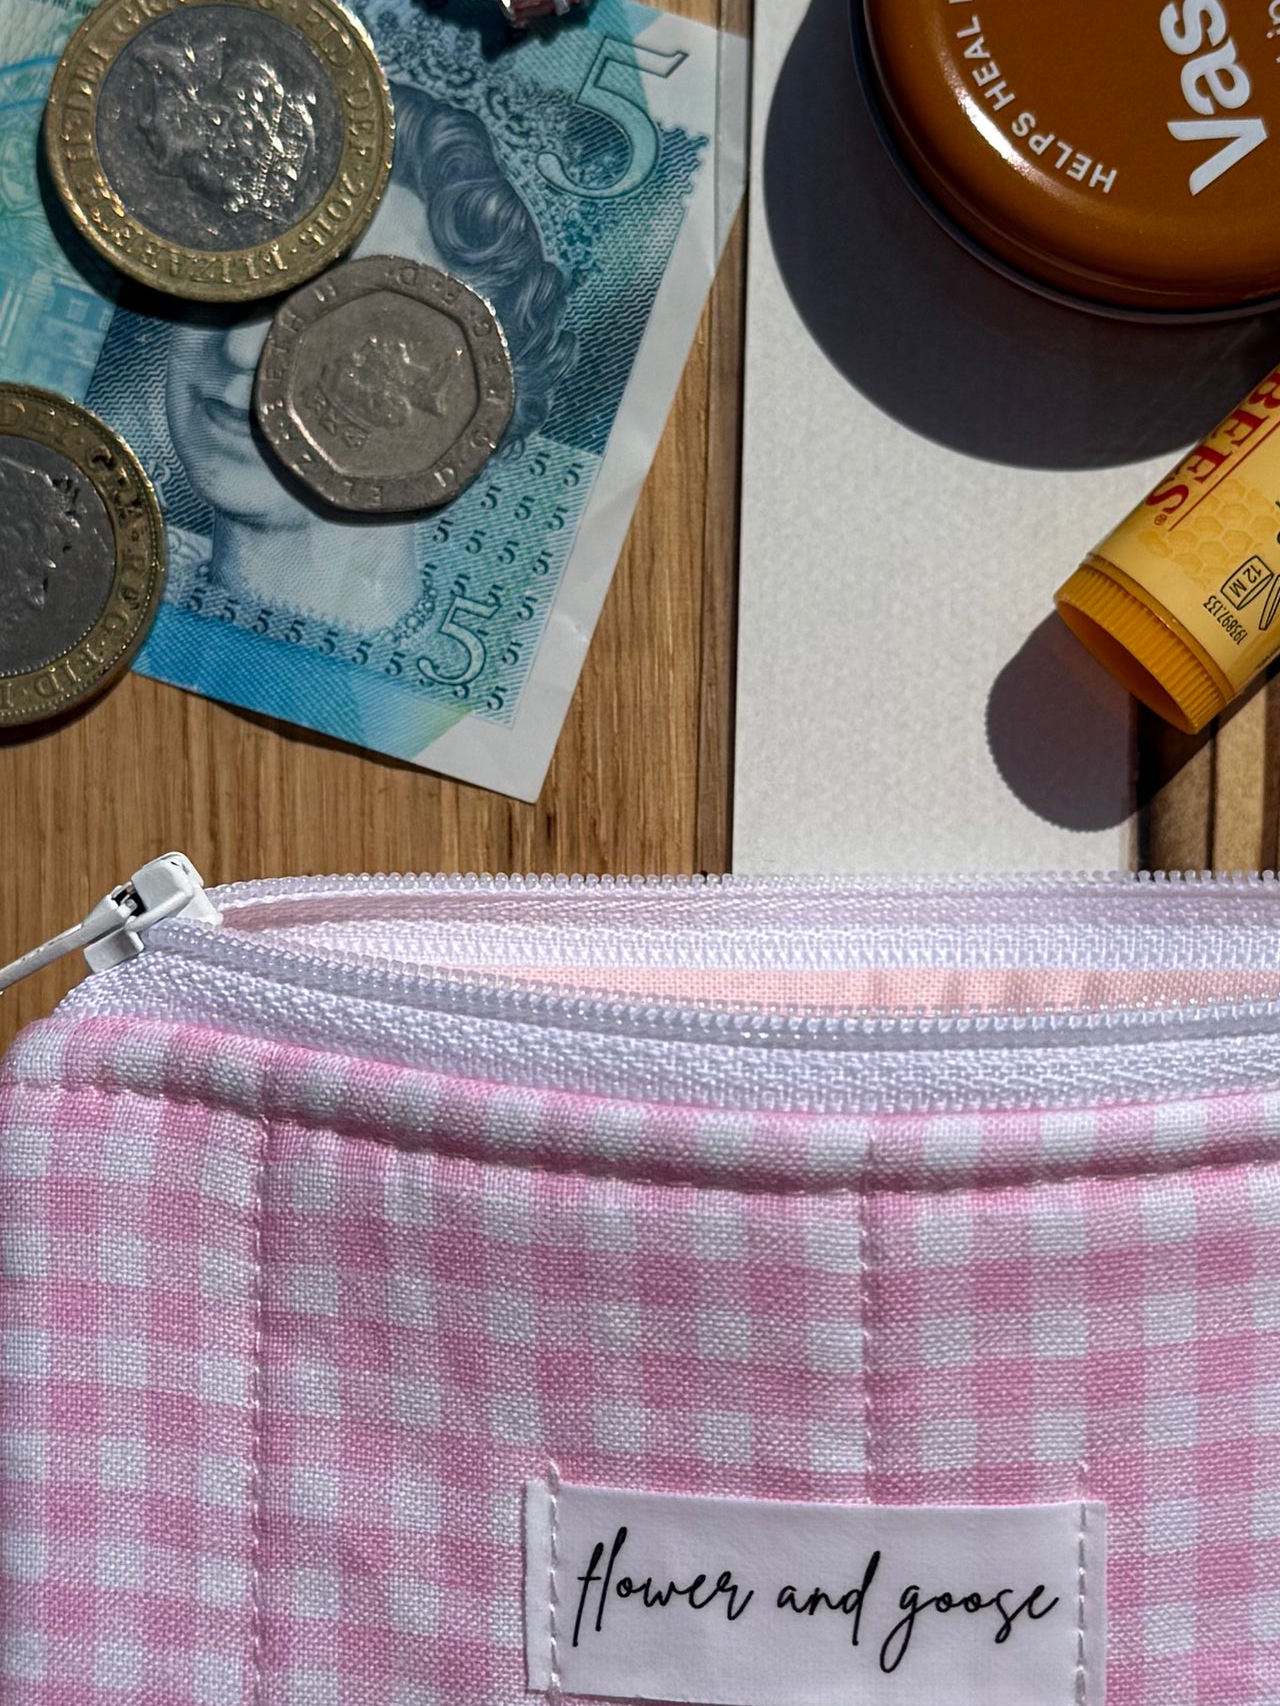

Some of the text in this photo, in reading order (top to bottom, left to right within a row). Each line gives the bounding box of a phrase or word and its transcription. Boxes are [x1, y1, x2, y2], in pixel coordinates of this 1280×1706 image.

[954, 15, 1015, 113] HEAL
[535, 35, 691, 201] 5
[1012, 111, 1118, 195] HELPS
[416, 595, 503, 687] 5
[572, 1525, 1063, 1675] flower and goose
